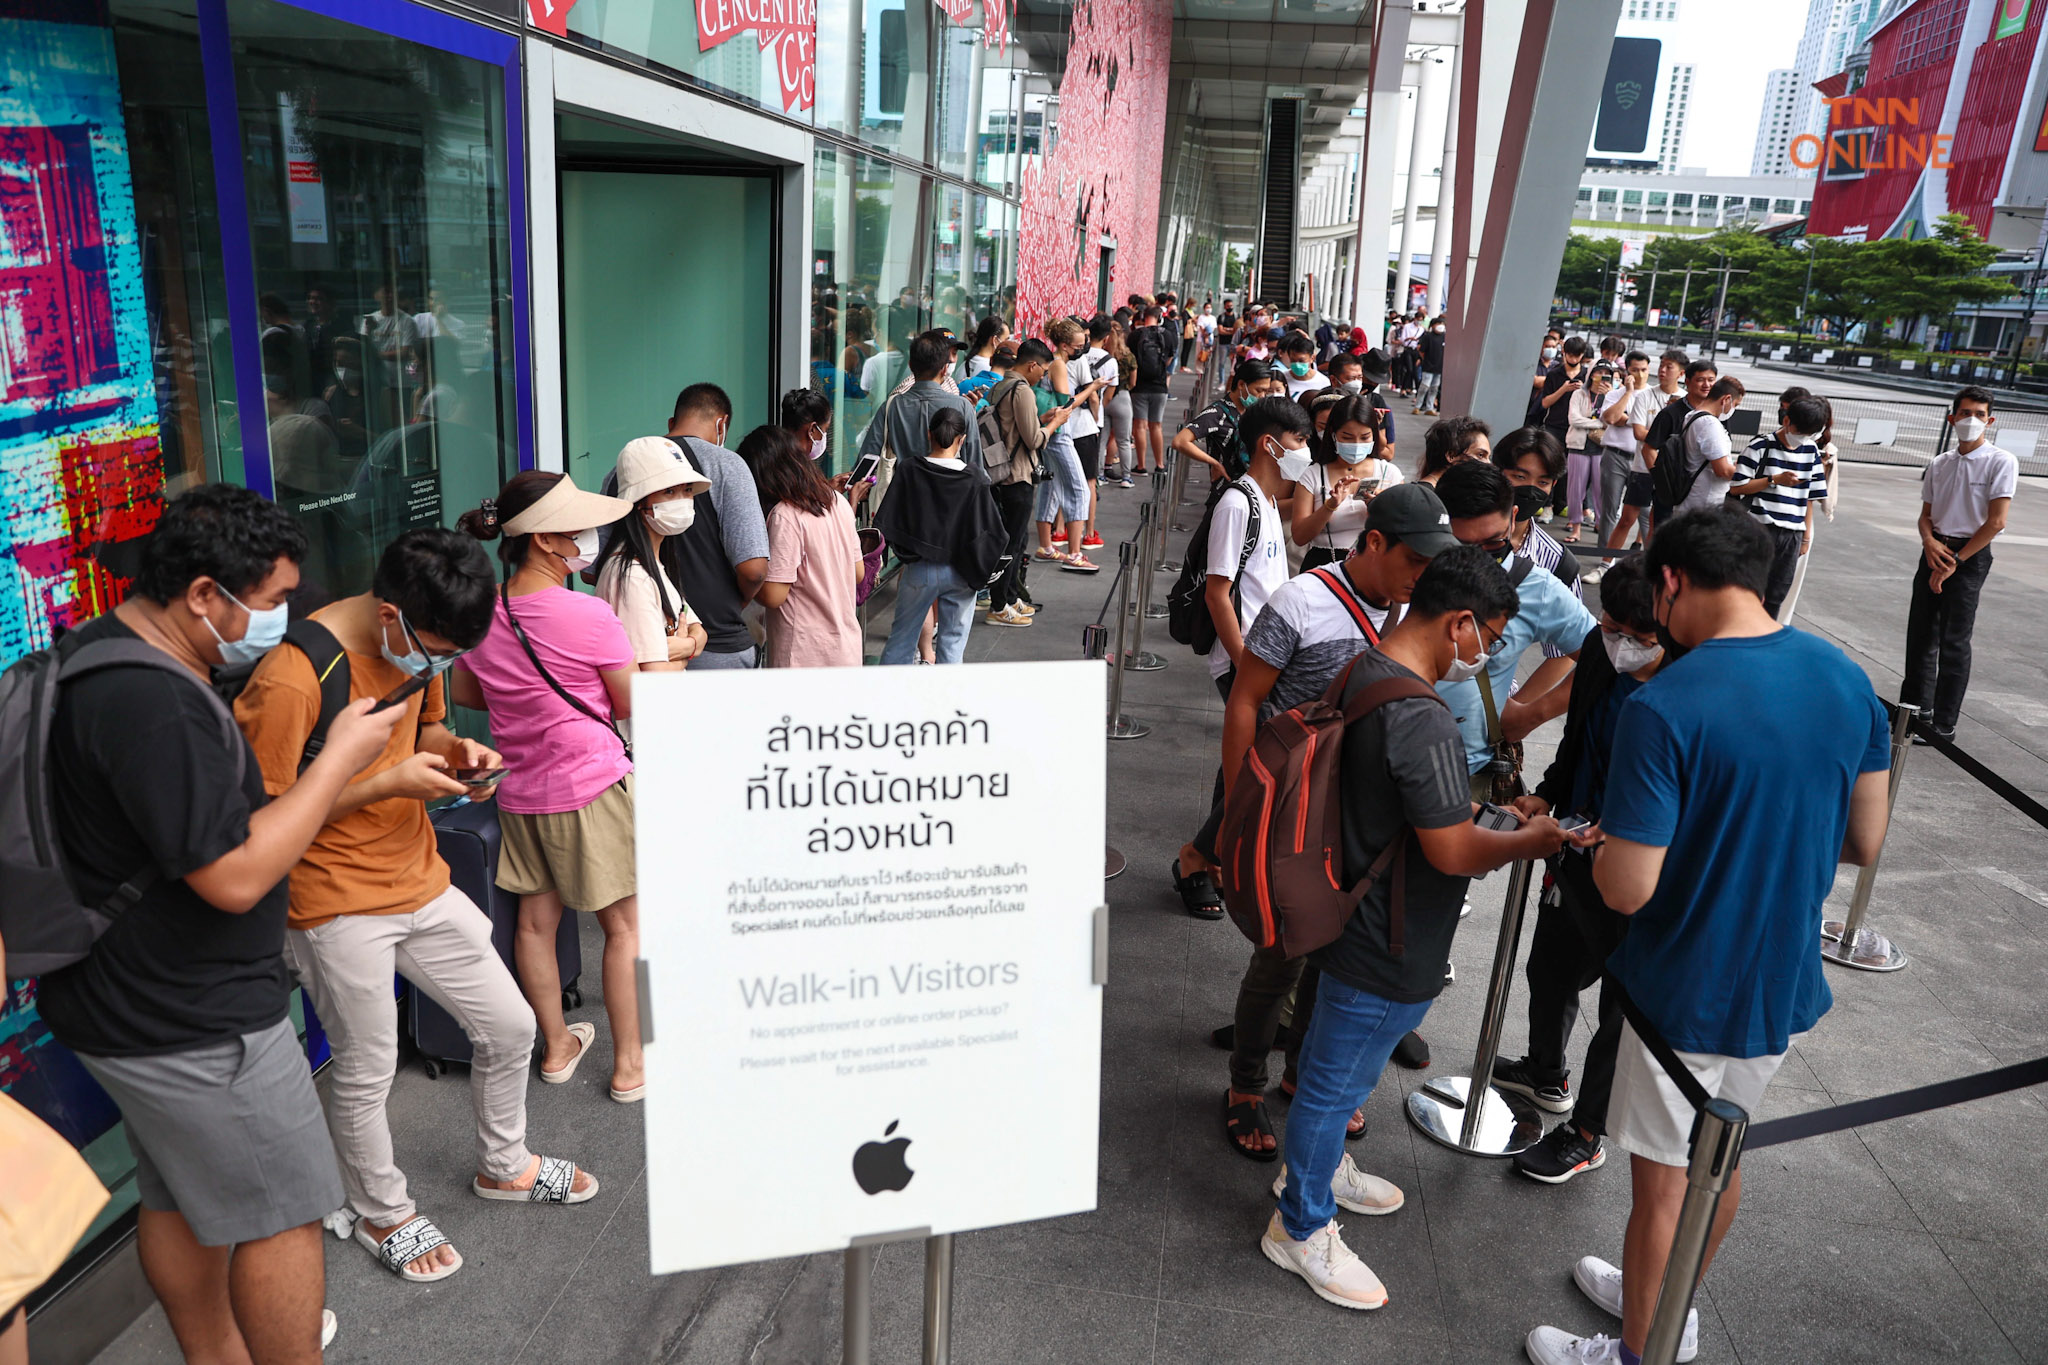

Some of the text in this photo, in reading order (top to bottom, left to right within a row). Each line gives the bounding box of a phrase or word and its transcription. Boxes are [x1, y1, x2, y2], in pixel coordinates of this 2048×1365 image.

[299, 492, 357, 512] Please Use Next Door
[767, 710, 989, 759] สำหรับลูกค้า
[747, 763, 1009, 811] ที่ไม่ได้นัดหมาย
[807, 812, 954, 853] ล่วงหน้า
[731, 918, 799, 936] Specialist
[739, 959, 1019, 1009] Walk-in Visitors
[750, 1002, 1010, 1040] No appointment or online order pickup?
[740, 1029, 1019, 1070] Please wait for the next available Specialist
[835, 1055, 931, 1077] for assistance.
